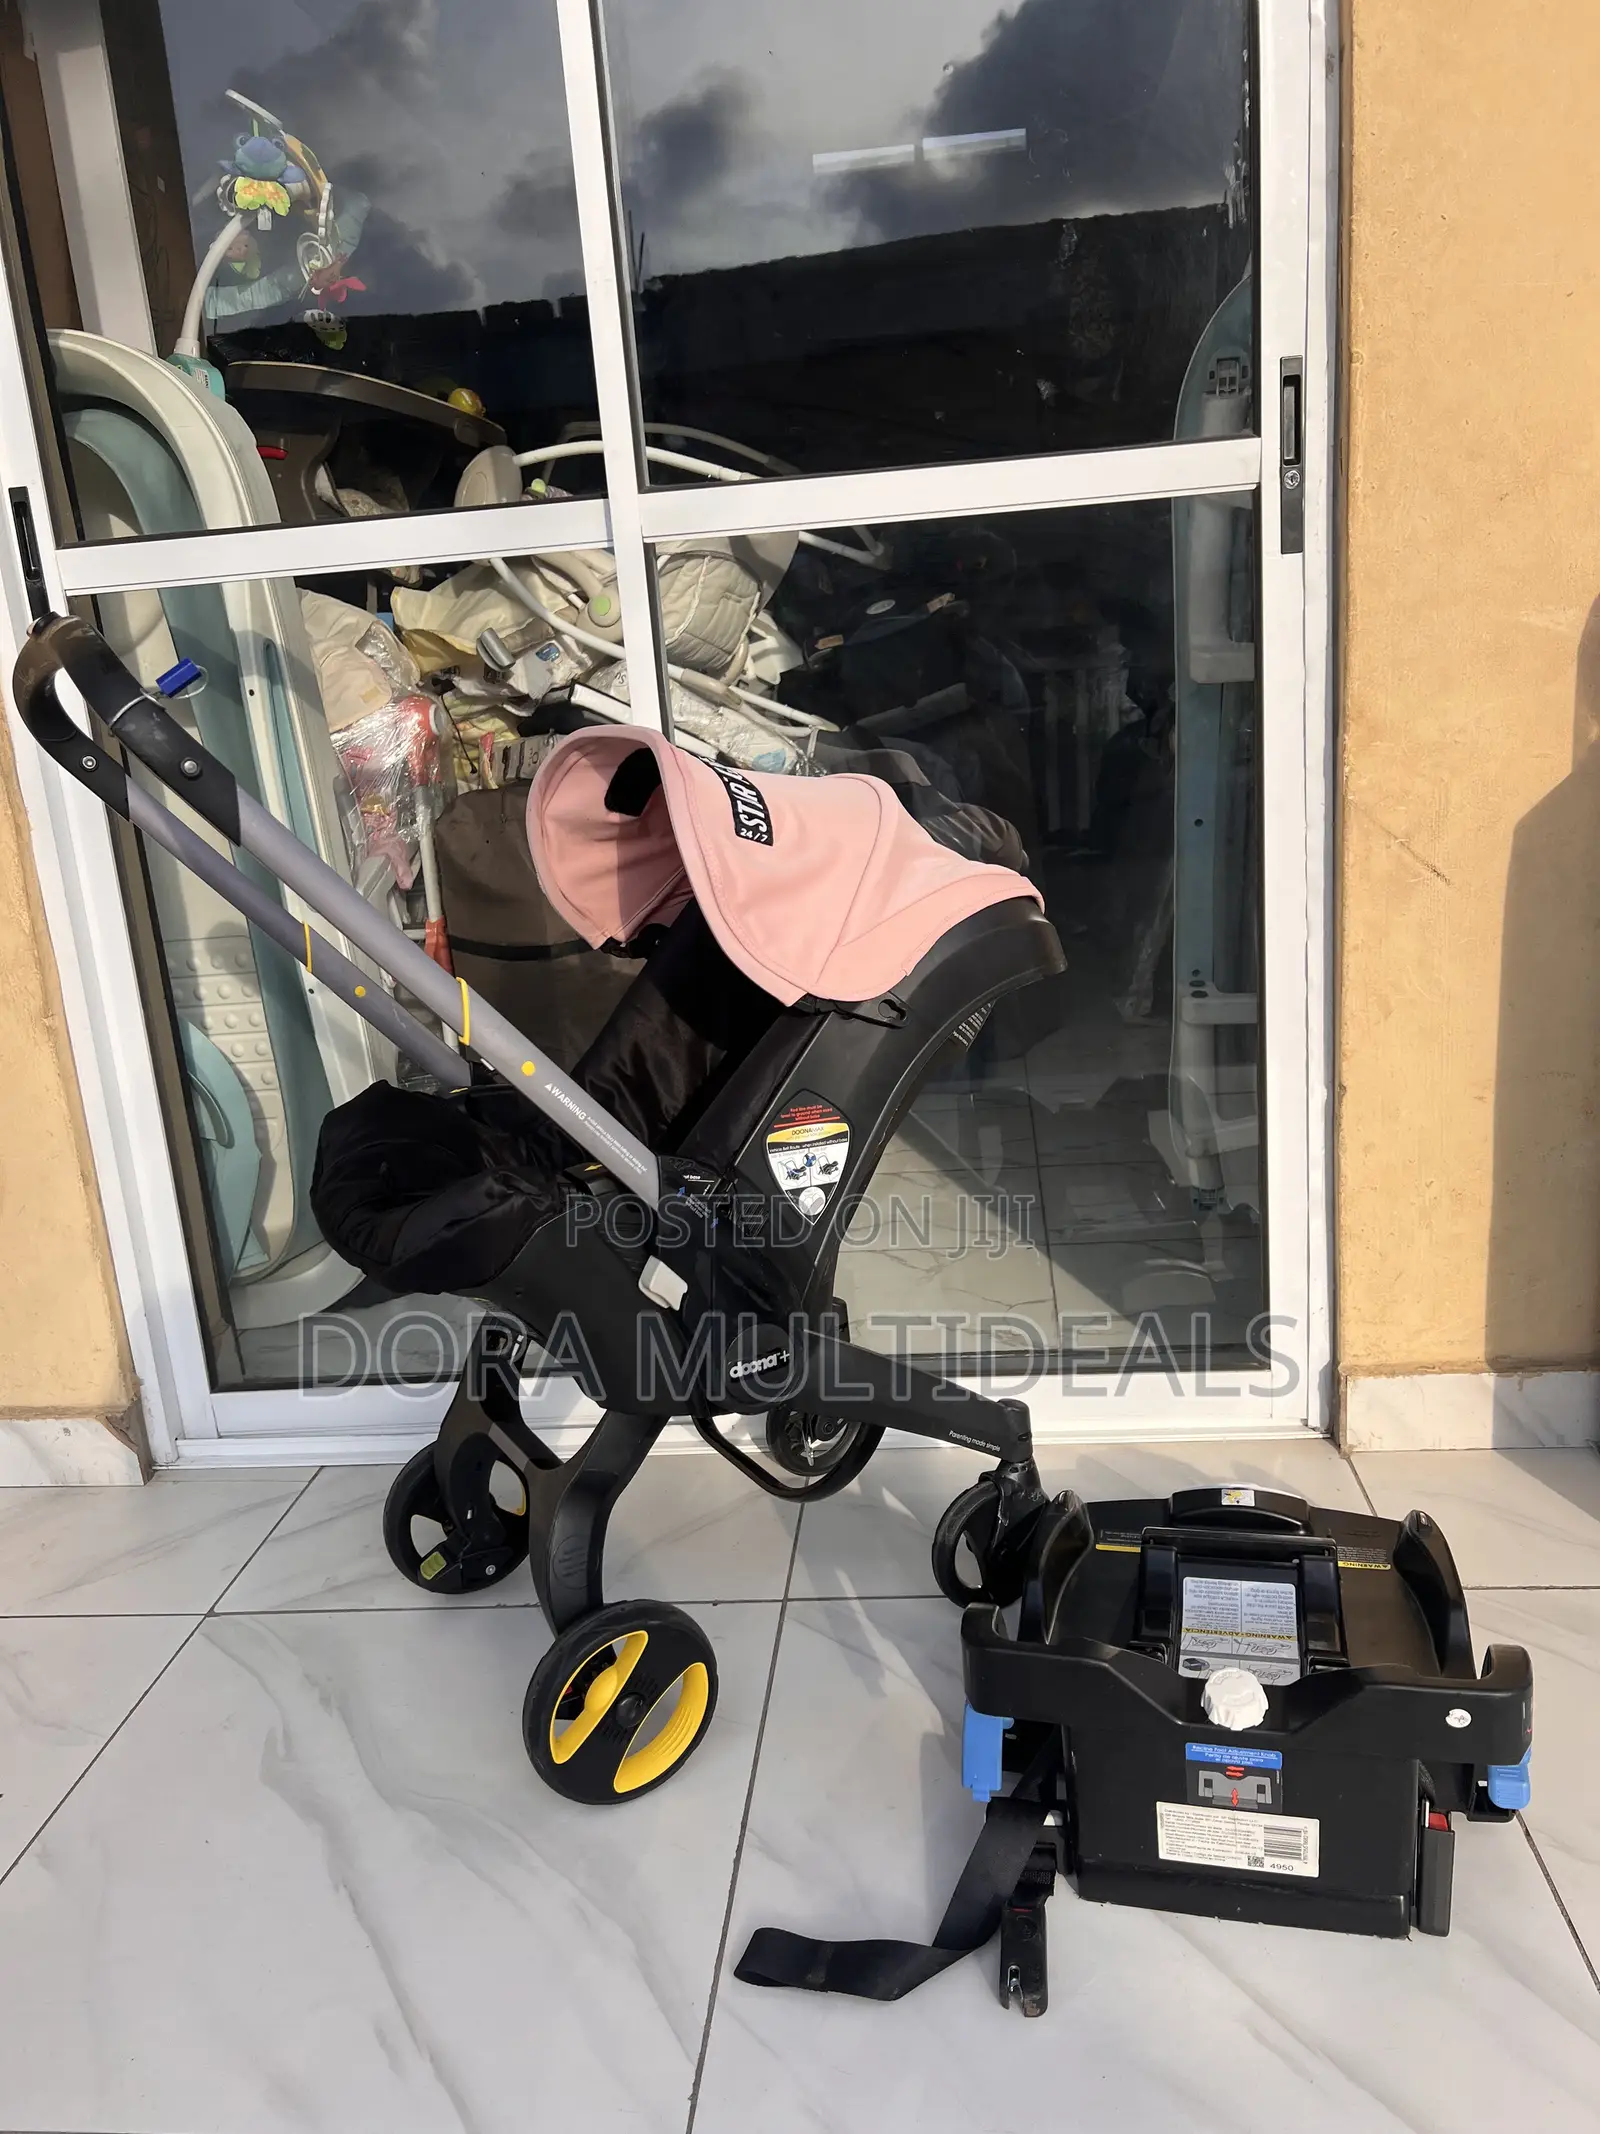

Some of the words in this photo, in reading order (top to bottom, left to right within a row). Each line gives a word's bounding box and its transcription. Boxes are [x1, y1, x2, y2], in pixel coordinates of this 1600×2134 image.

[740, 828, 768, 842] 24/7
[551, 1086, 587, 1120] WARNING
[948, 1429, 972, 1444] Parenting
[972, 1438, 987, 1448] made
[986, 1442, 1001, 1452] simple
[1269, 1862, 1294, 1872] 4950
